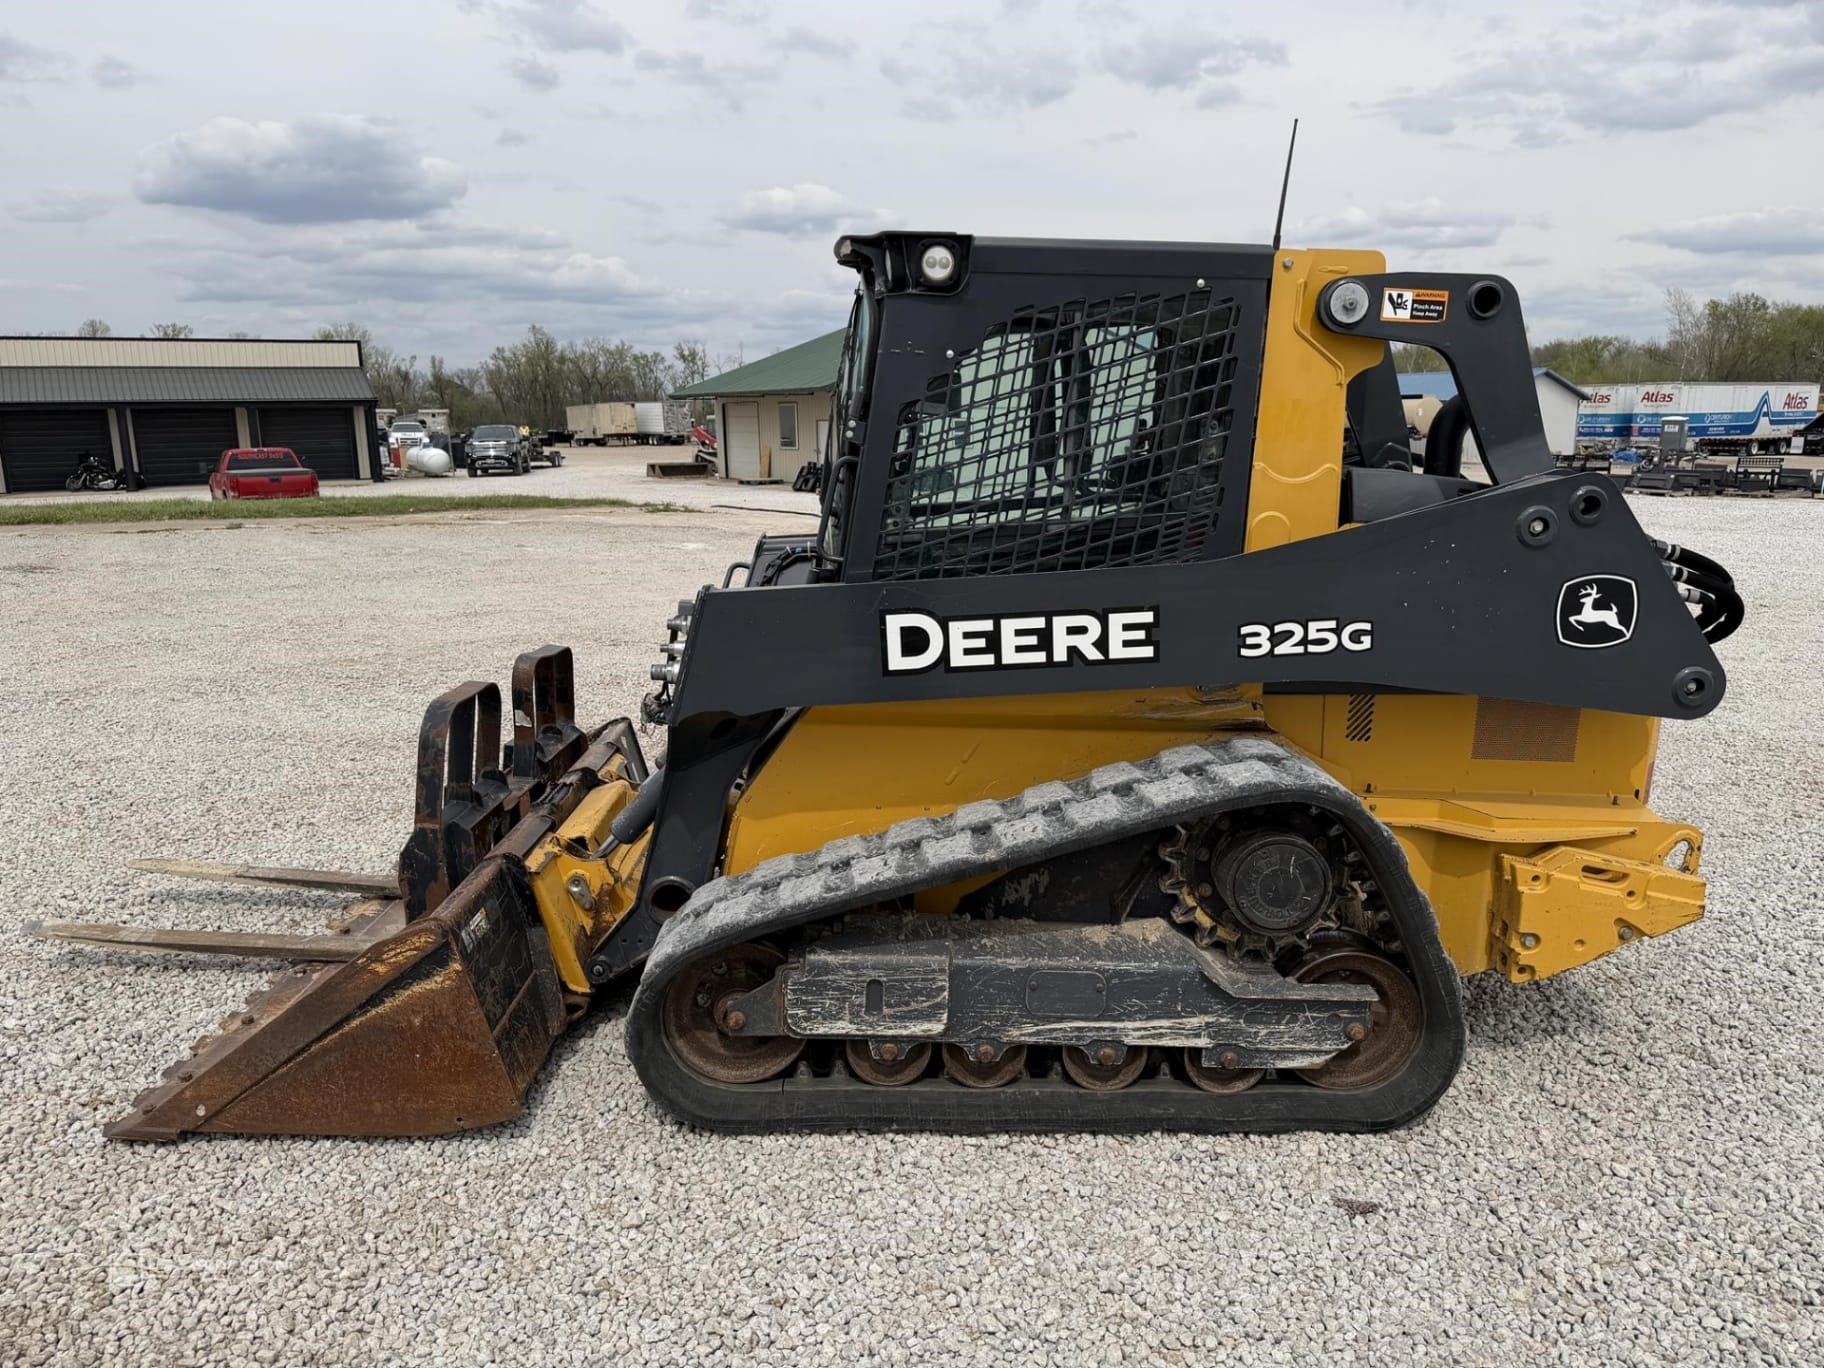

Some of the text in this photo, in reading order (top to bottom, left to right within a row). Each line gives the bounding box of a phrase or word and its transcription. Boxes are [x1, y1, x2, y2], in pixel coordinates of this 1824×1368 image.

[1641, 391, 1674, 403] Atlas
[1783, 392, 1809, 410] Atlas
[885, 610, 1155, 671] DEERE
[1239, 619, 1373, 657] 325G
